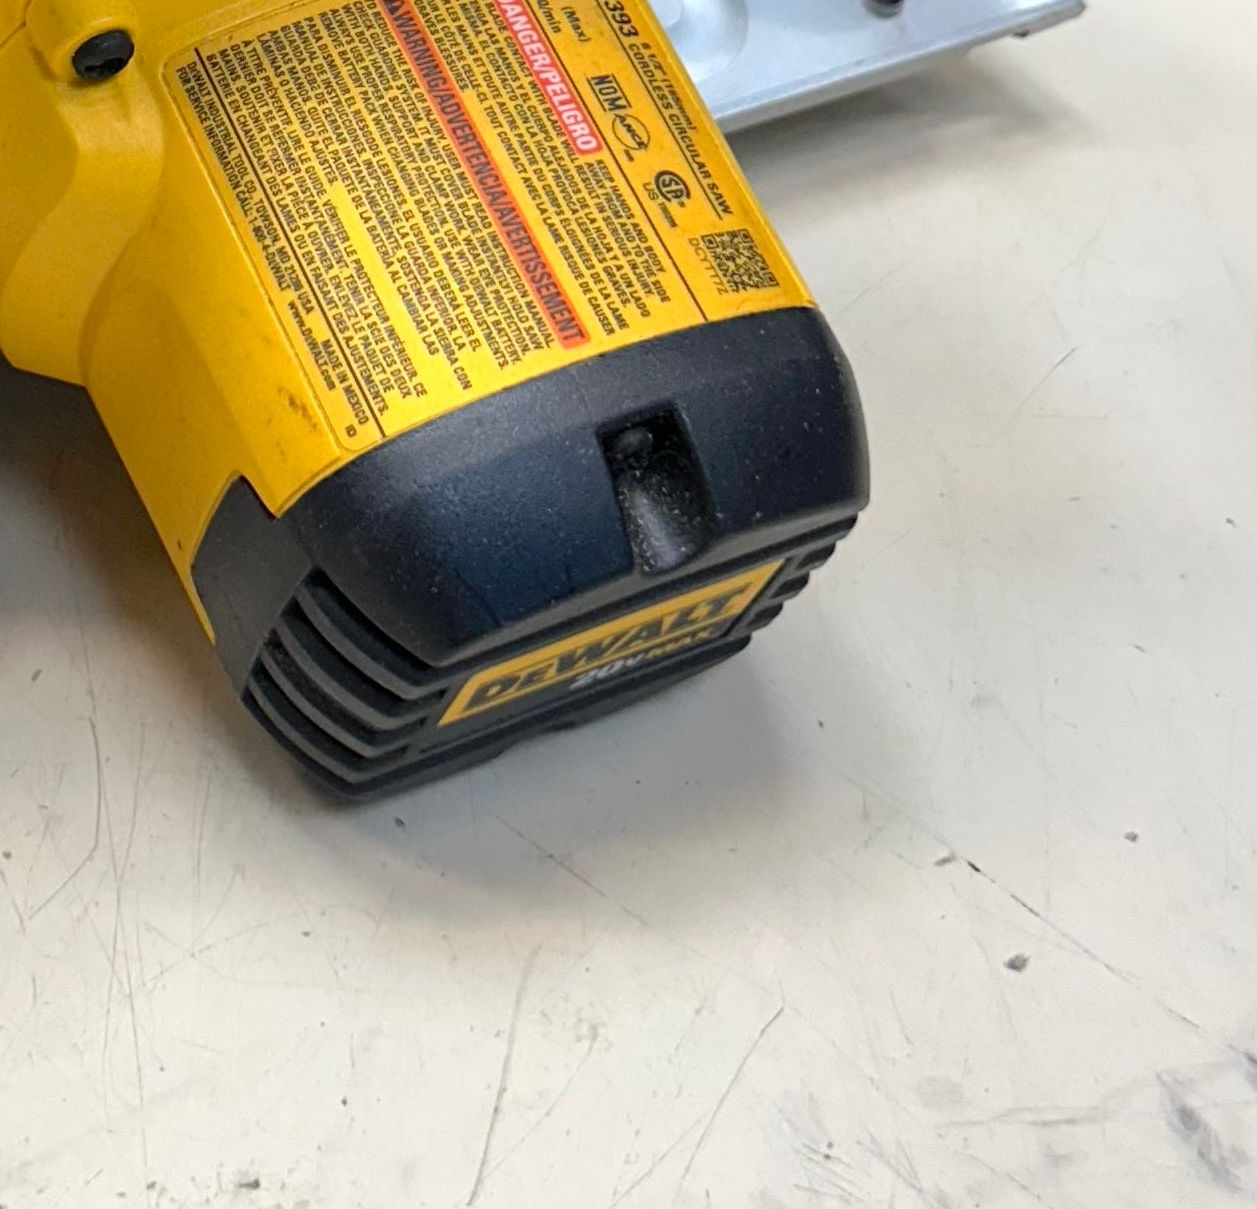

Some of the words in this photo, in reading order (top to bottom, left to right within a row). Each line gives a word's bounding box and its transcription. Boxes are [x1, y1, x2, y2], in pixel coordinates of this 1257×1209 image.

[559, 4, 592, 44] (Max)
[588, 70, 629, 114] NOM
[626, 42, 673, 110] CORDLESS
[666, 112, 713, 180] CIRCULAR
[705, 181, 733, 216] SAW
[389, 10, 584, 345] WARNING/ADVERTENCIA/AVERTISSEMENT
[319, 338, 343, 370] MADE
[334, 369, 350, 384] IN
[341, 383, 370, 426] MEXICO
